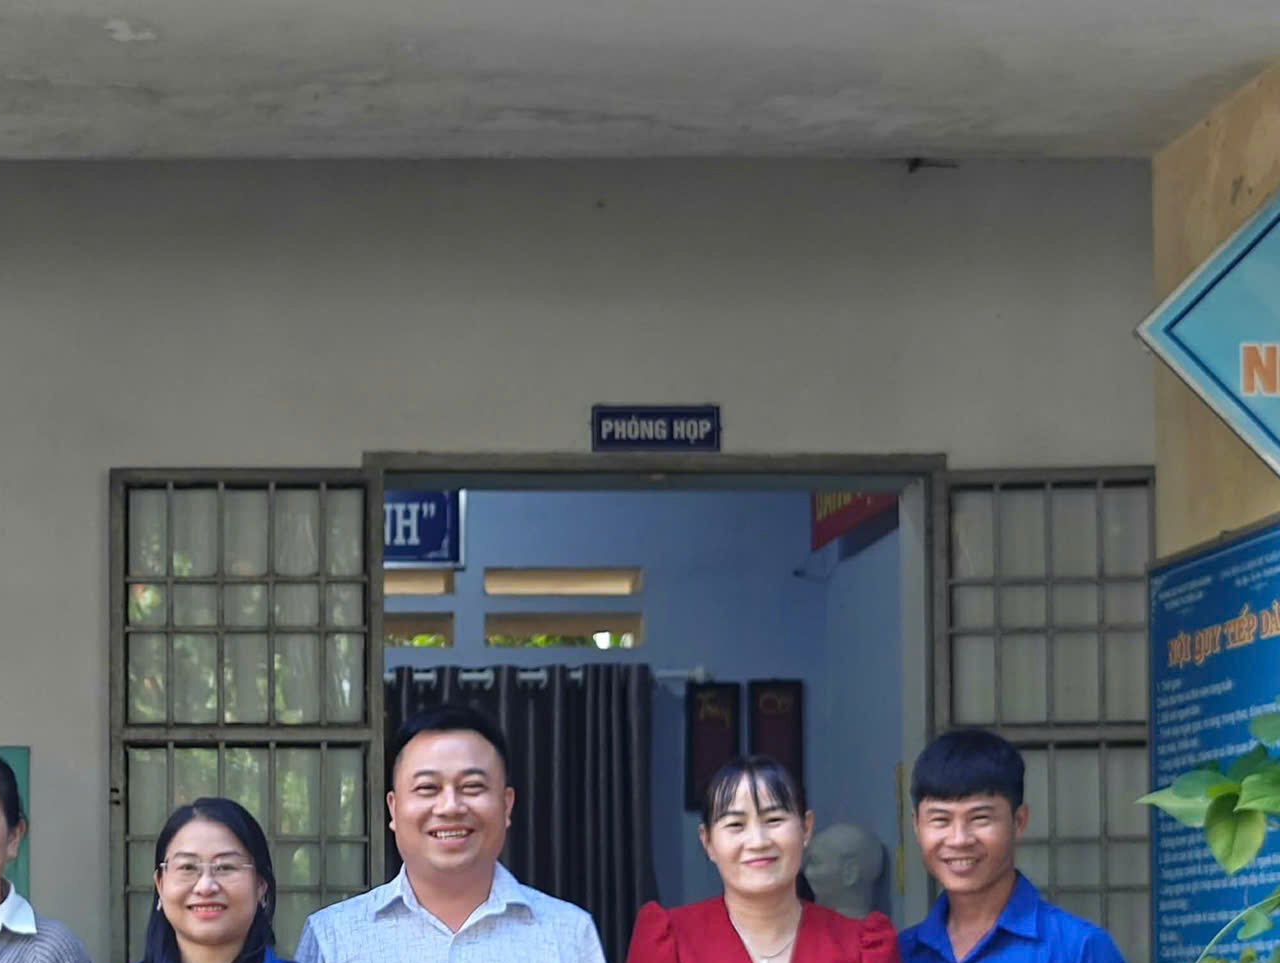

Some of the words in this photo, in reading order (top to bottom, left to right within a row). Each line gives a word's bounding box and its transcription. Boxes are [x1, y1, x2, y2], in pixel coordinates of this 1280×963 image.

[1240, 342, 1280, 396] N
[600, 414, 668, 441] PHÒNG
[672, 418, 712, 445] HỌP
